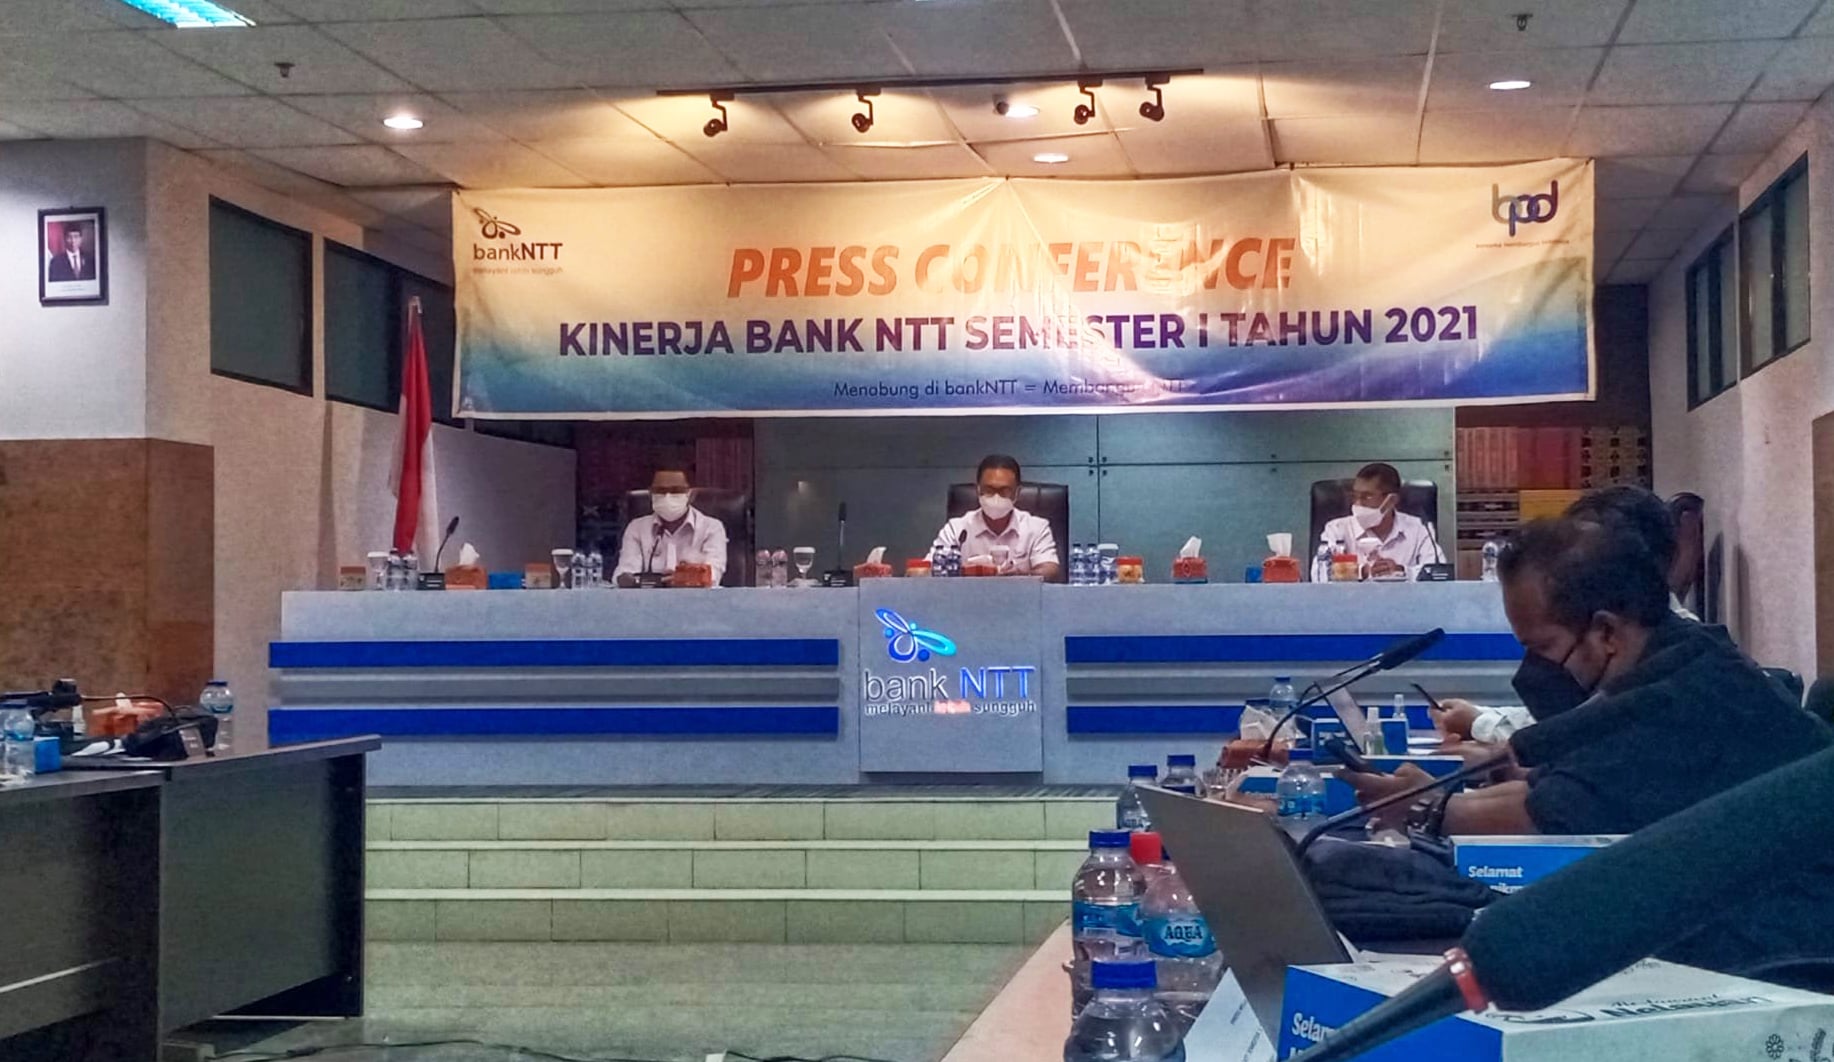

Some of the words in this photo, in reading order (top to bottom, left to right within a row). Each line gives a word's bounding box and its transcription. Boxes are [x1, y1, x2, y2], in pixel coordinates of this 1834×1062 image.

[473, 243, 563, 260] bankNTT
[727, 245, 899, 298] PRESS
[915, 237, 1295, 294] CONFERNCE
[559, 320, 735, 356] KINERJA
[746, 318, 864, 354] BANK
[875, 316, 955, 352] NTT
[965, 313, 1186, 350] SEMESTER
[1199, 312, 1207, 348] I
[1220, 308, 1373, 347] TAHUN
[1384, 305, 1478, 344] 2021
[834, 381, 919, 399] Menabung
[925, 380, 940, 395] di
[945, 378, 1017, 395] bankNTT
[864, 668, 949, 701] bank
[960, 666, 1036, 699] NTT
[974, 700, 1037, 717] sungguh
[1468, 866, 1524, 878] Selamat
